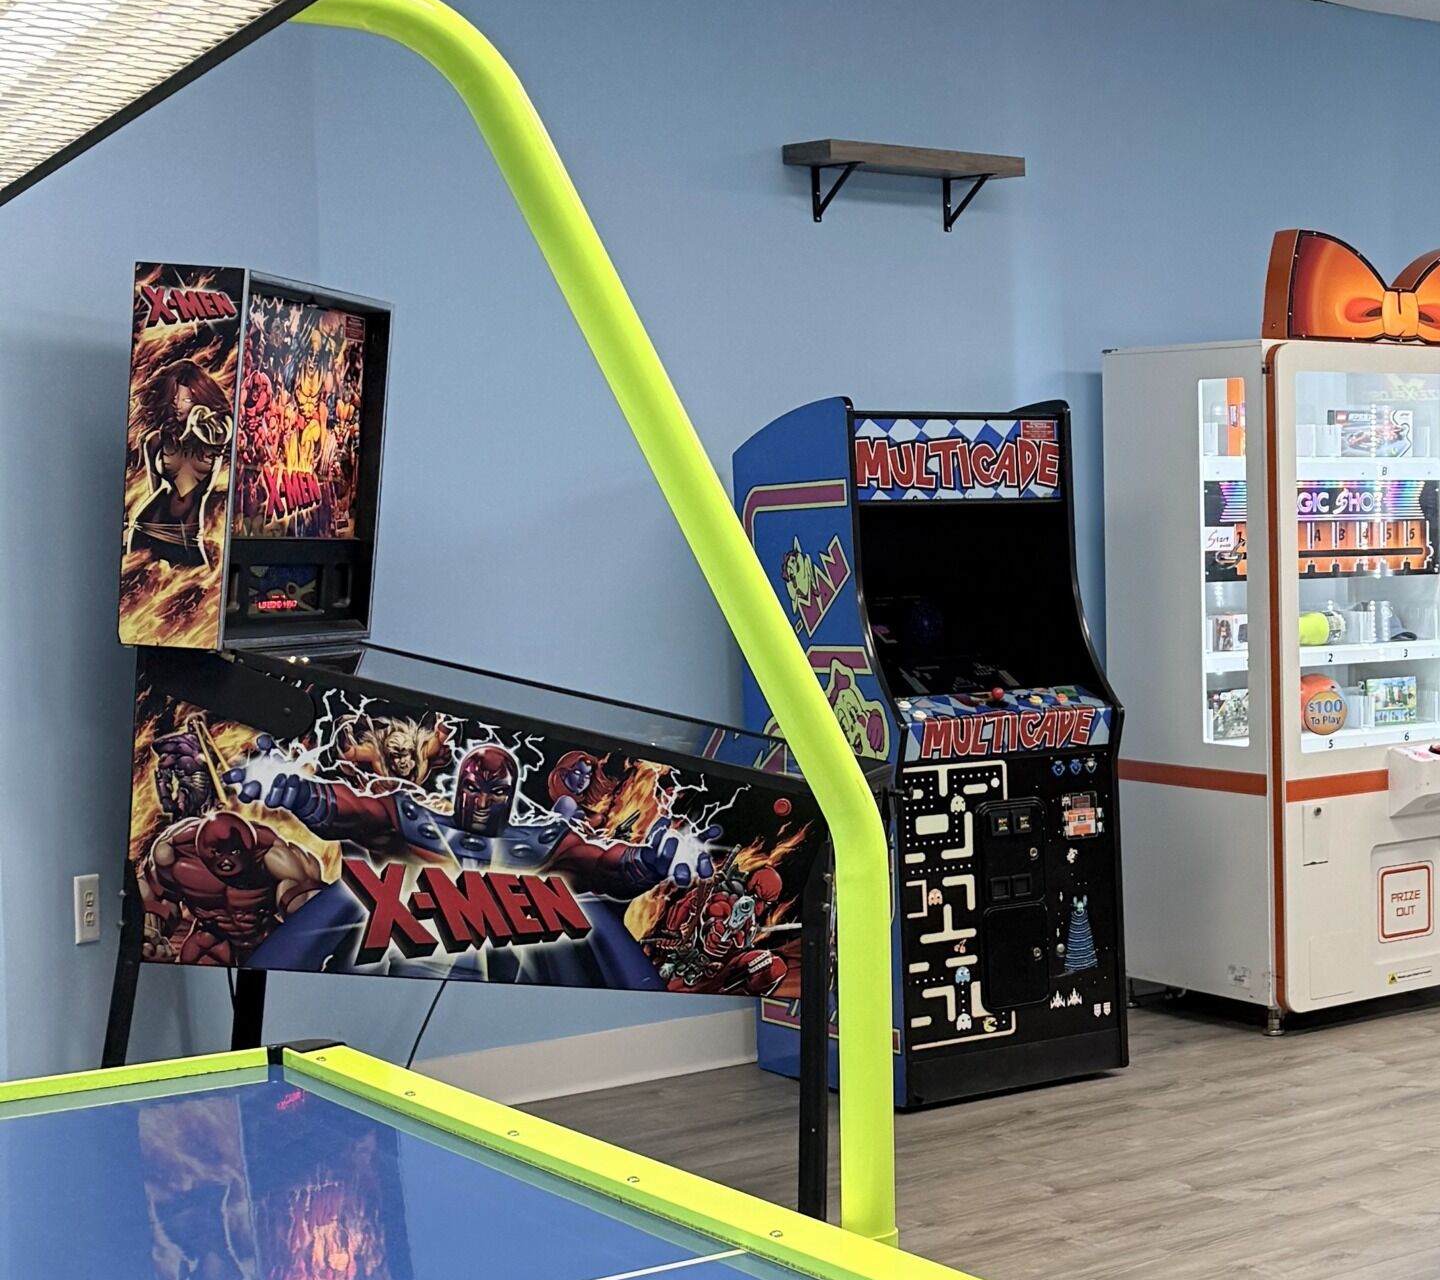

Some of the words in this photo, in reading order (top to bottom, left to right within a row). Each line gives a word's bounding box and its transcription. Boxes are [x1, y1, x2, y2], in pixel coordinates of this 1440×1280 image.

[142, 286, 237, 326] X-MEN
[855, 437, 1060, 490] MULTICADE
[263, 465, 321, 520] X-MEN
[1314, 529, 1321, 542] A
[1339, 528, 1346, 540] B
[1386, 528, 1392, 540] 5
[1409, 528, 1415, 540] 6
[1328, 653, 1334, 663] 2
[1403, 649, 1409, 658] 3
[1310, 716, 1320, 725] To
[1322, 715, 1341, 725] Play
[921, 707, 1095, 758] MULTICADE
[1404, 732, 1410, 741] 6
[1328, 739, 1334, 749] 5
[1391, 889, 1421, 903] PRIZE
[343, 859, 592, 962] X-MEN
[1396, 905, 1416, 917] OUT
